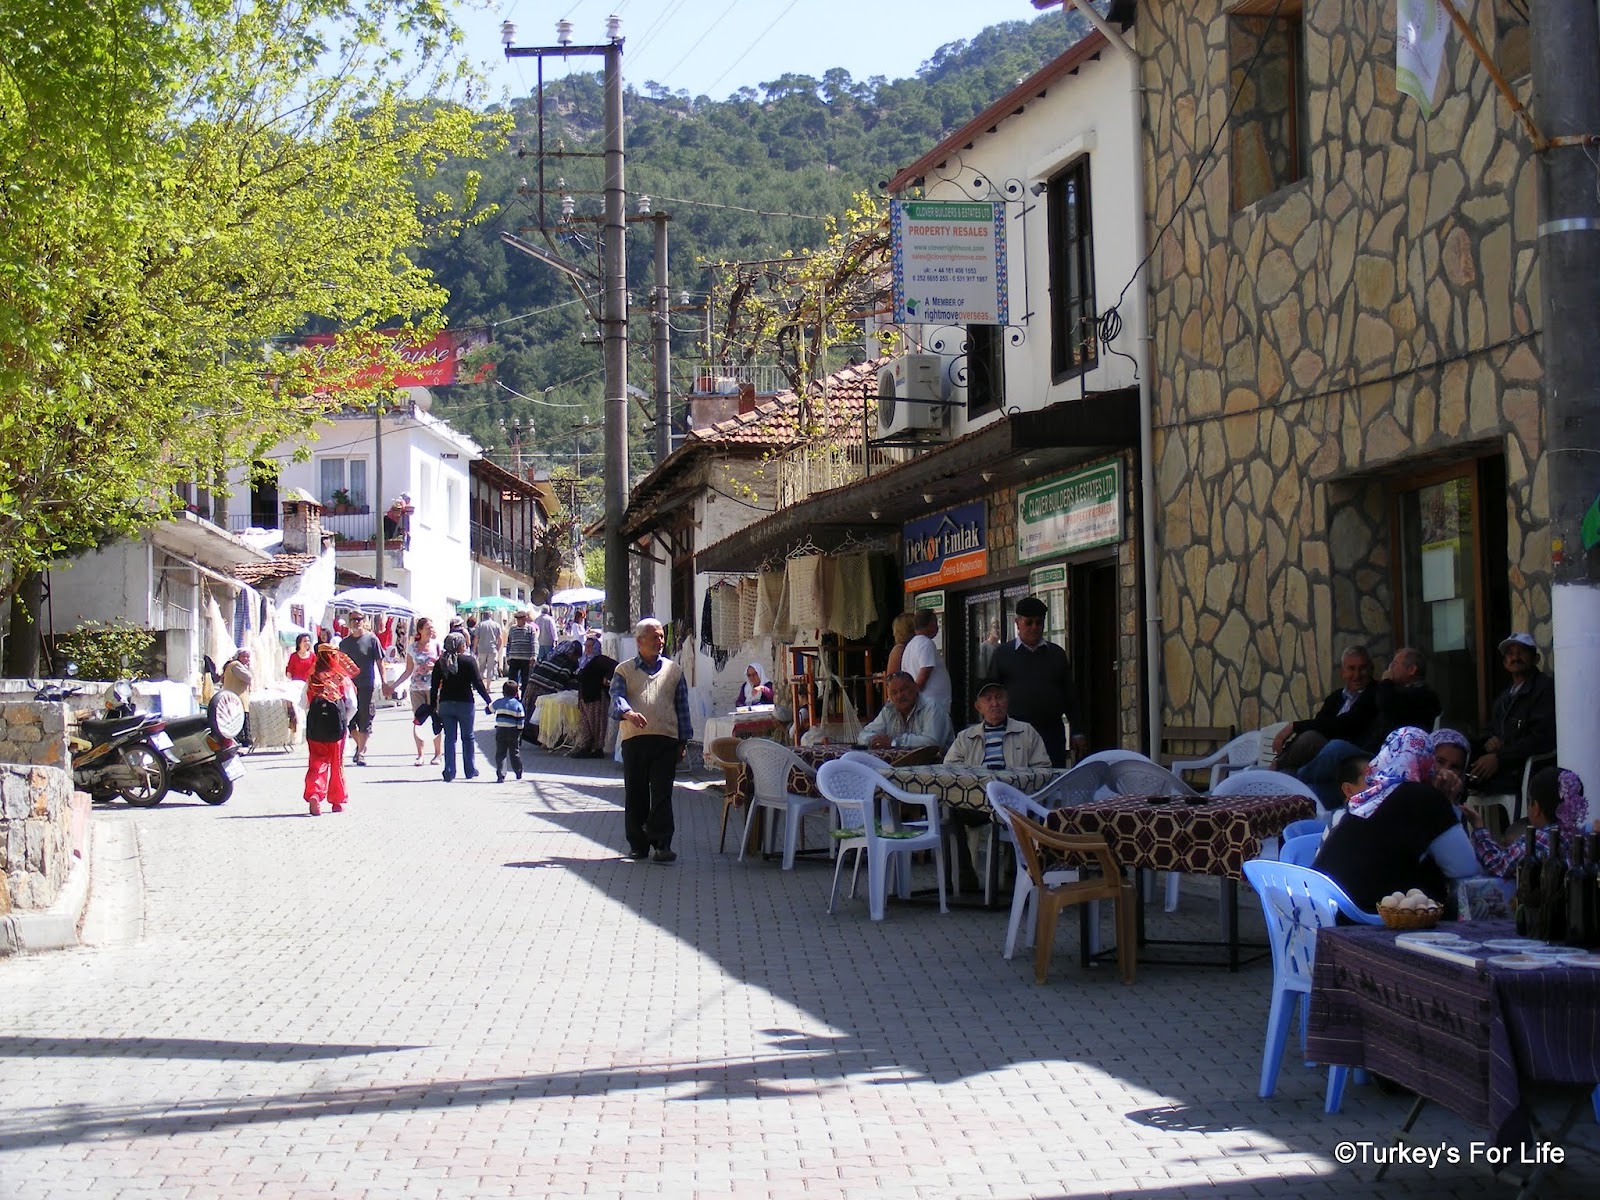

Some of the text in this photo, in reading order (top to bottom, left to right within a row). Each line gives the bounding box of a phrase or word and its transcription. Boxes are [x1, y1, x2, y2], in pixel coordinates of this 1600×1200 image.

[908, 225, 988, 237] PROPERTY RESALES
[924, 297, 930, 306] A
[1028, 494, 1048, 518] CLOVER
[1049, 486, 1074, 511] BUILDERS
[1079, 478, 1103, 502] ESTATES
[906, 521, 980, 566] Dekor Emlak
[960, 558, 983, 573] Construction
